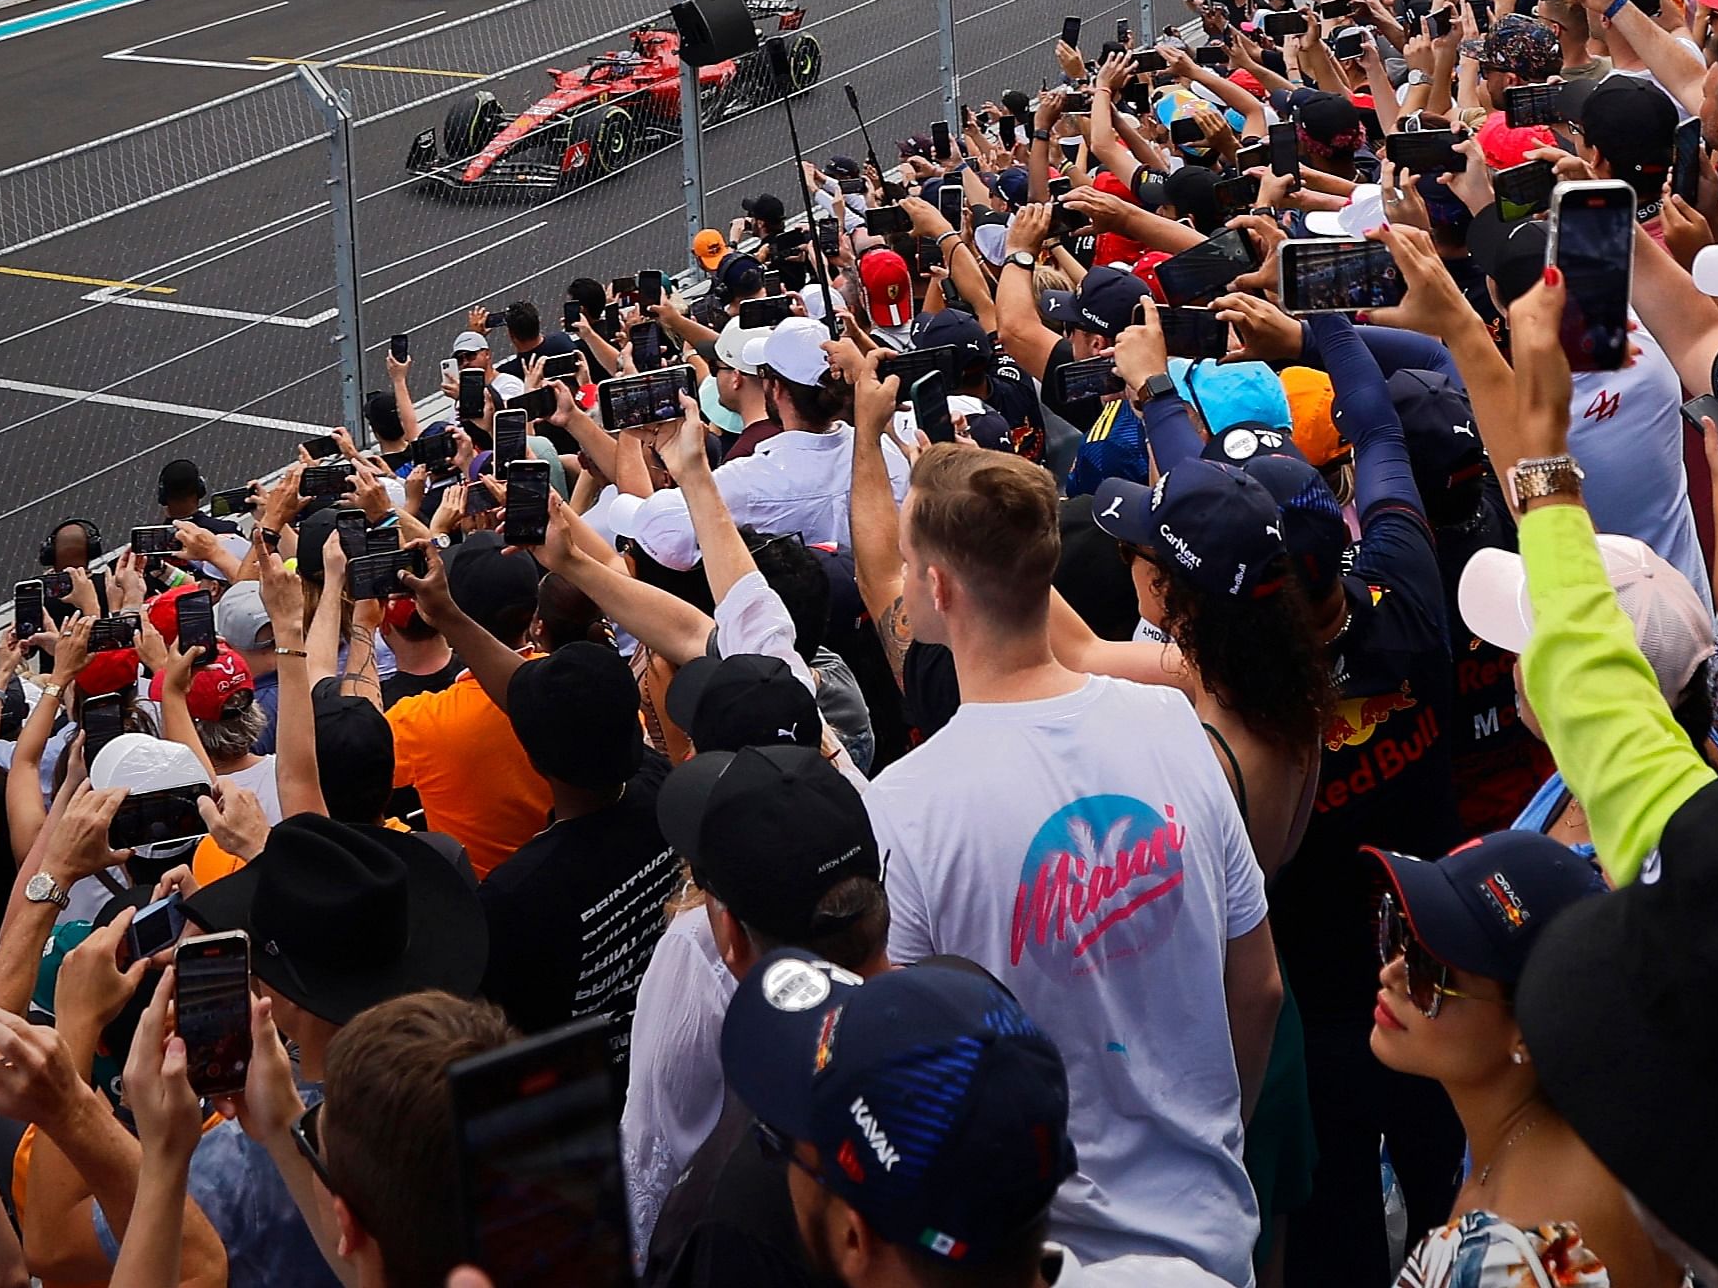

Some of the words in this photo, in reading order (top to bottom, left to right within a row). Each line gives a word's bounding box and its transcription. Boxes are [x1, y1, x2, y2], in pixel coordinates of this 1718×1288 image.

[1082, 307, 1109, 329] CarNext
[1160, 524, 1203, 568] CarNext
[817, 855, 839, 874] ASTON
[839, 844, 862, 864] MARTIN
[1011, 804, 1186, 967] Miami
[1494, 872, 1531, 921] ORACLE
[850, 1095, 901, 1173] KAVAK
